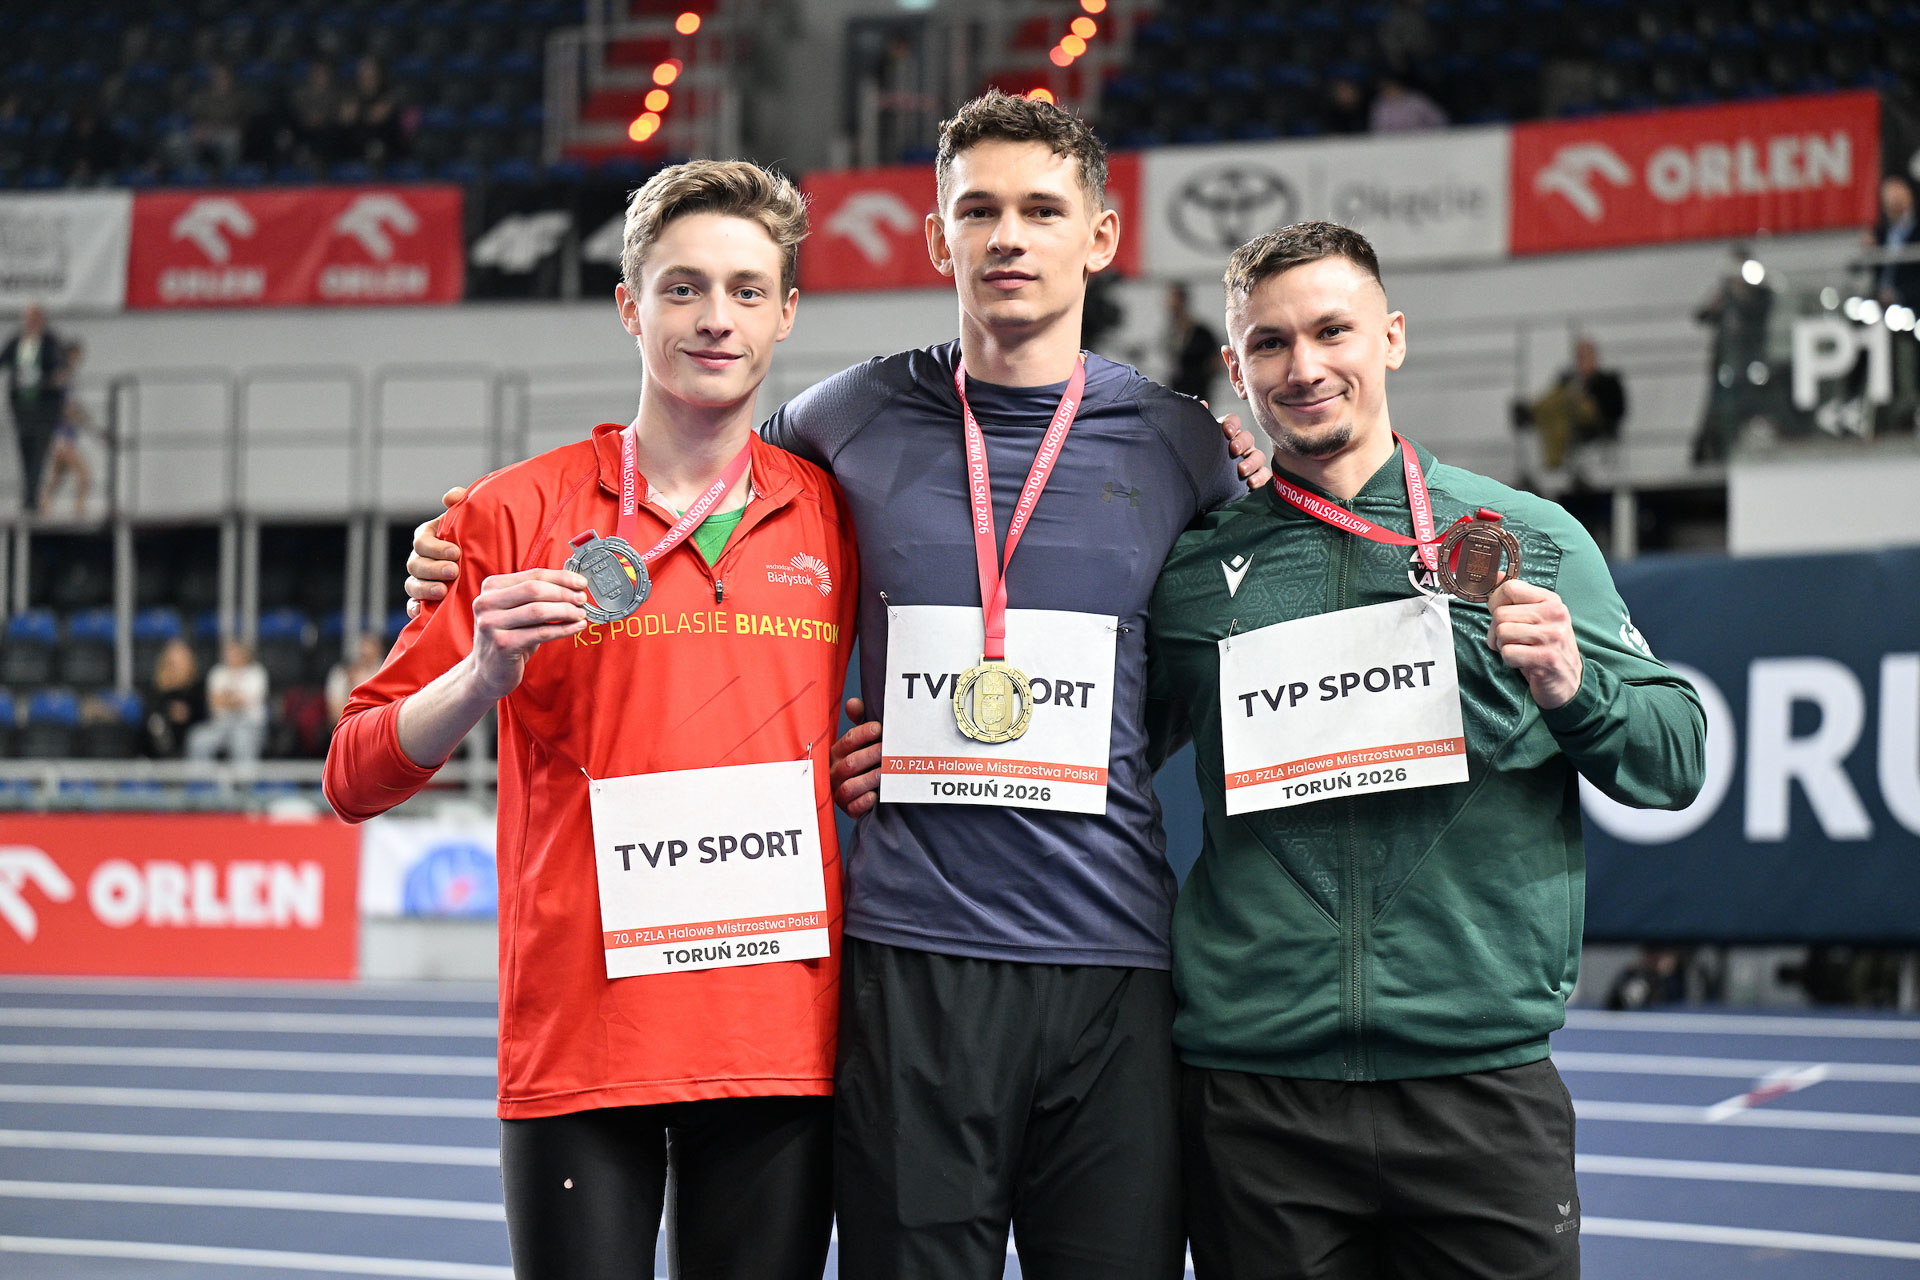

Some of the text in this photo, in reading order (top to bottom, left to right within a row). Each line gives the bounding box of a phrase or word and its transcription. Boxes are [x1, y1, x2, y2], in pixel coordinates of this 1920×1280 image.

[1646, 131, 1852, 203] ORLEN
[158, 264, 267, 300] ORLEN
[318, 262, 428, 298] ORLEN
[1791, 317, 1893, 411] P1
[623, 455, 635, 516] MISTRZOSTWA
[972, 463, 987, 505] POLSKI
[1010, 398, 1075, 536] MISTRZOSTWA POLSKI 2026
[676, 478, 726, 532] MISTRZOSTWA
[1276, 482, 1372, 534] MISTRZOSTWA POLSKI
[1408, 461, 1429, 527] MISTRZOSTWA
[976, 507, 990, 534] 2026
[767, 571, 814, 587] Białystok
[573, 611, 839, 648] KS PODLASIE BIAŁYSTOK
[1012, 678, 1096, 708] ORT
[1238, 660, 1435, 718] TVP SPORT
[889, 759, 1098, 782] 70. PZLA Halowe Mistrzostwa Polski
[1234, 741, 1455, 785] 70. PZLA Halowe Mistrzostwa Polski
[1281, 768, 1407, 800] TORUŃ 2026
[930, 779, 1051, 801] TORUŃ 2026
[614, 829, 803, 871] TVP SPORT
[88, 858, 325, 929] ORLEN
[613, 914, 819, 945] 70. PZLA Halowe Mistrzostwa Polski
[663, 940, 780, 965] TORUŃ 2026
